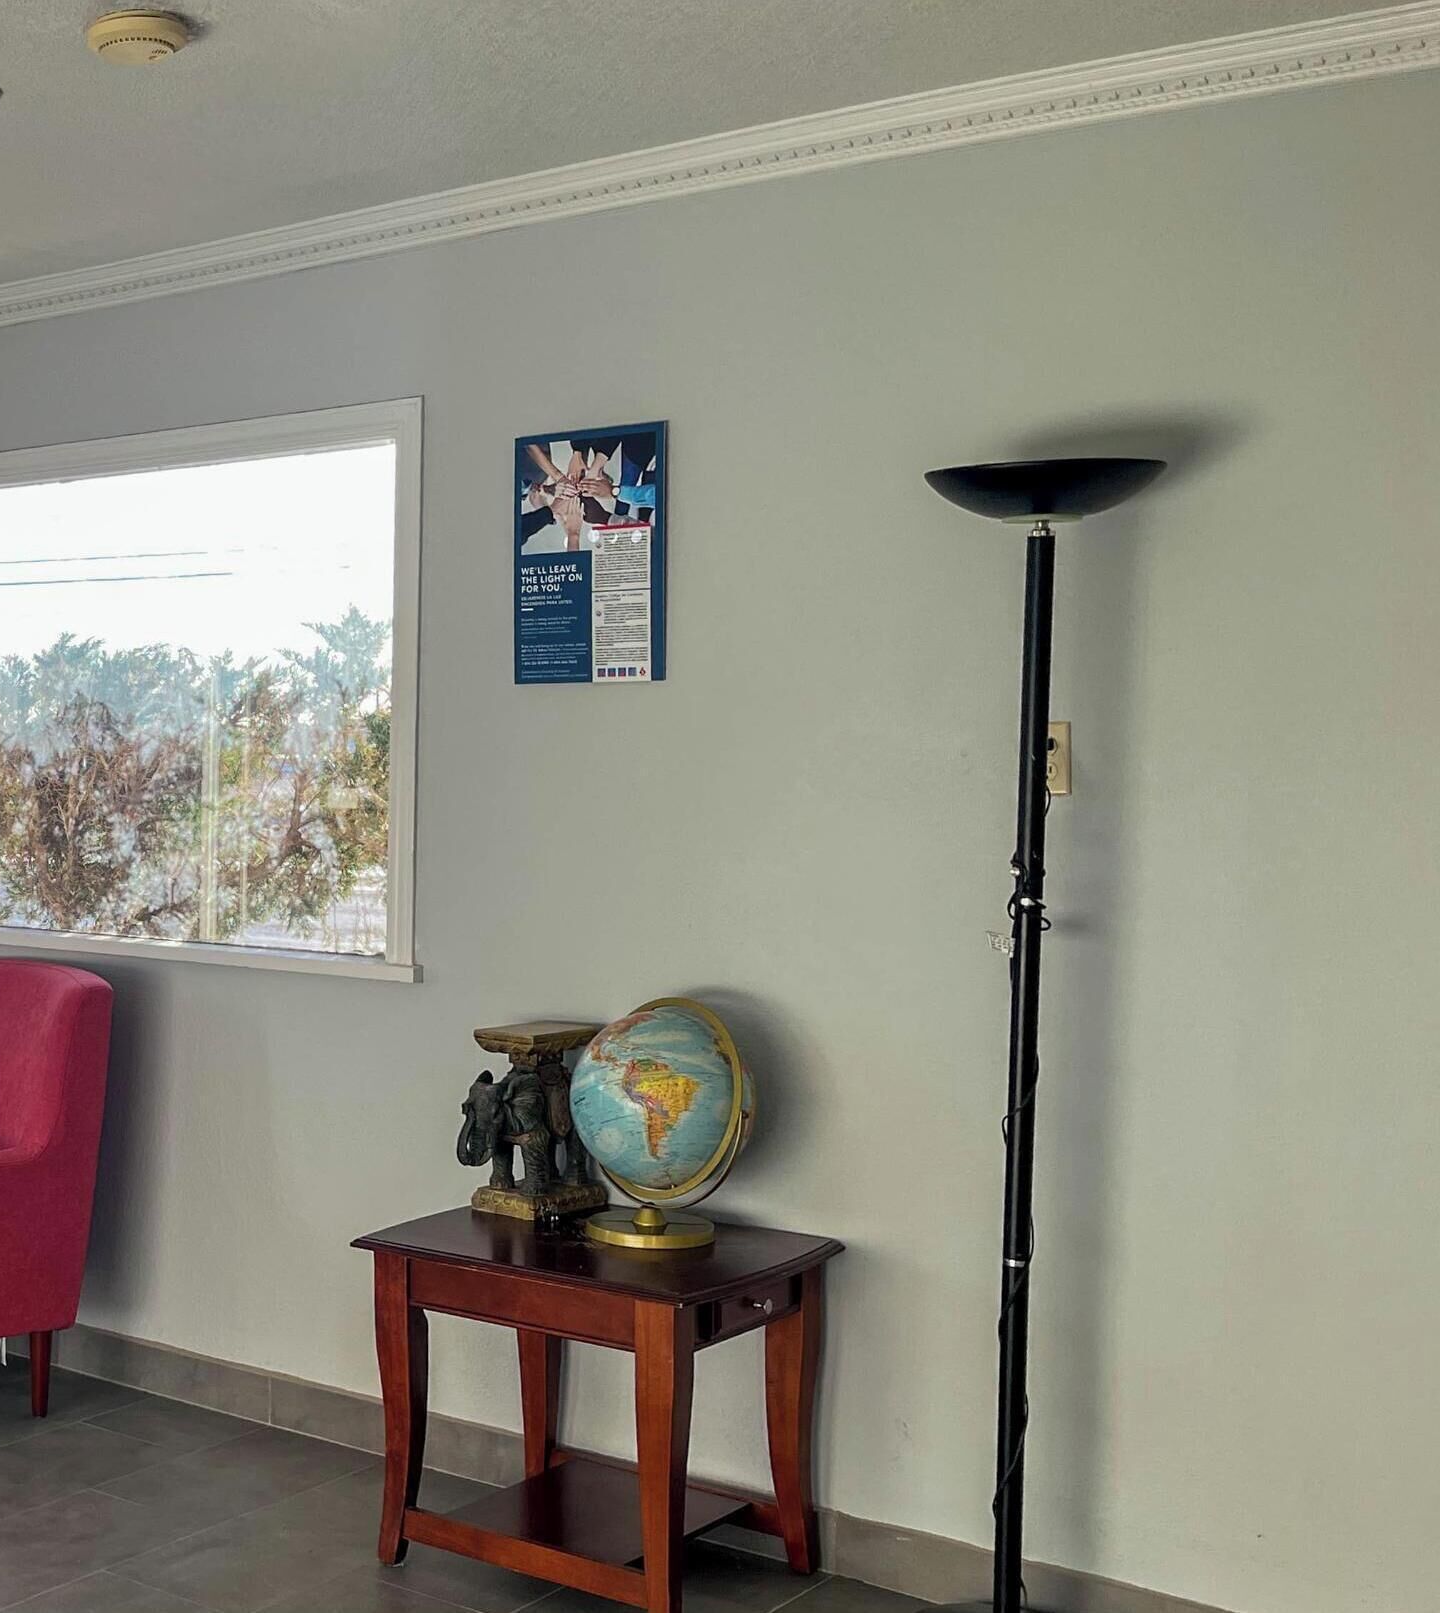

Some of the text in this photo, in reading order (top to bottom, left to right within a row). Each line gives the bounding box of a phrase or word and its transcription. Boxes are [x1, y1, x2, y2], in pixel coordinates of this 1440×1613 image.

[521, 564, 577, 575] WE'LL LEAVE
[521, 573, 583, 585] THE LIGHT ON
[521, 584, 563, 593] FOR YOU.
